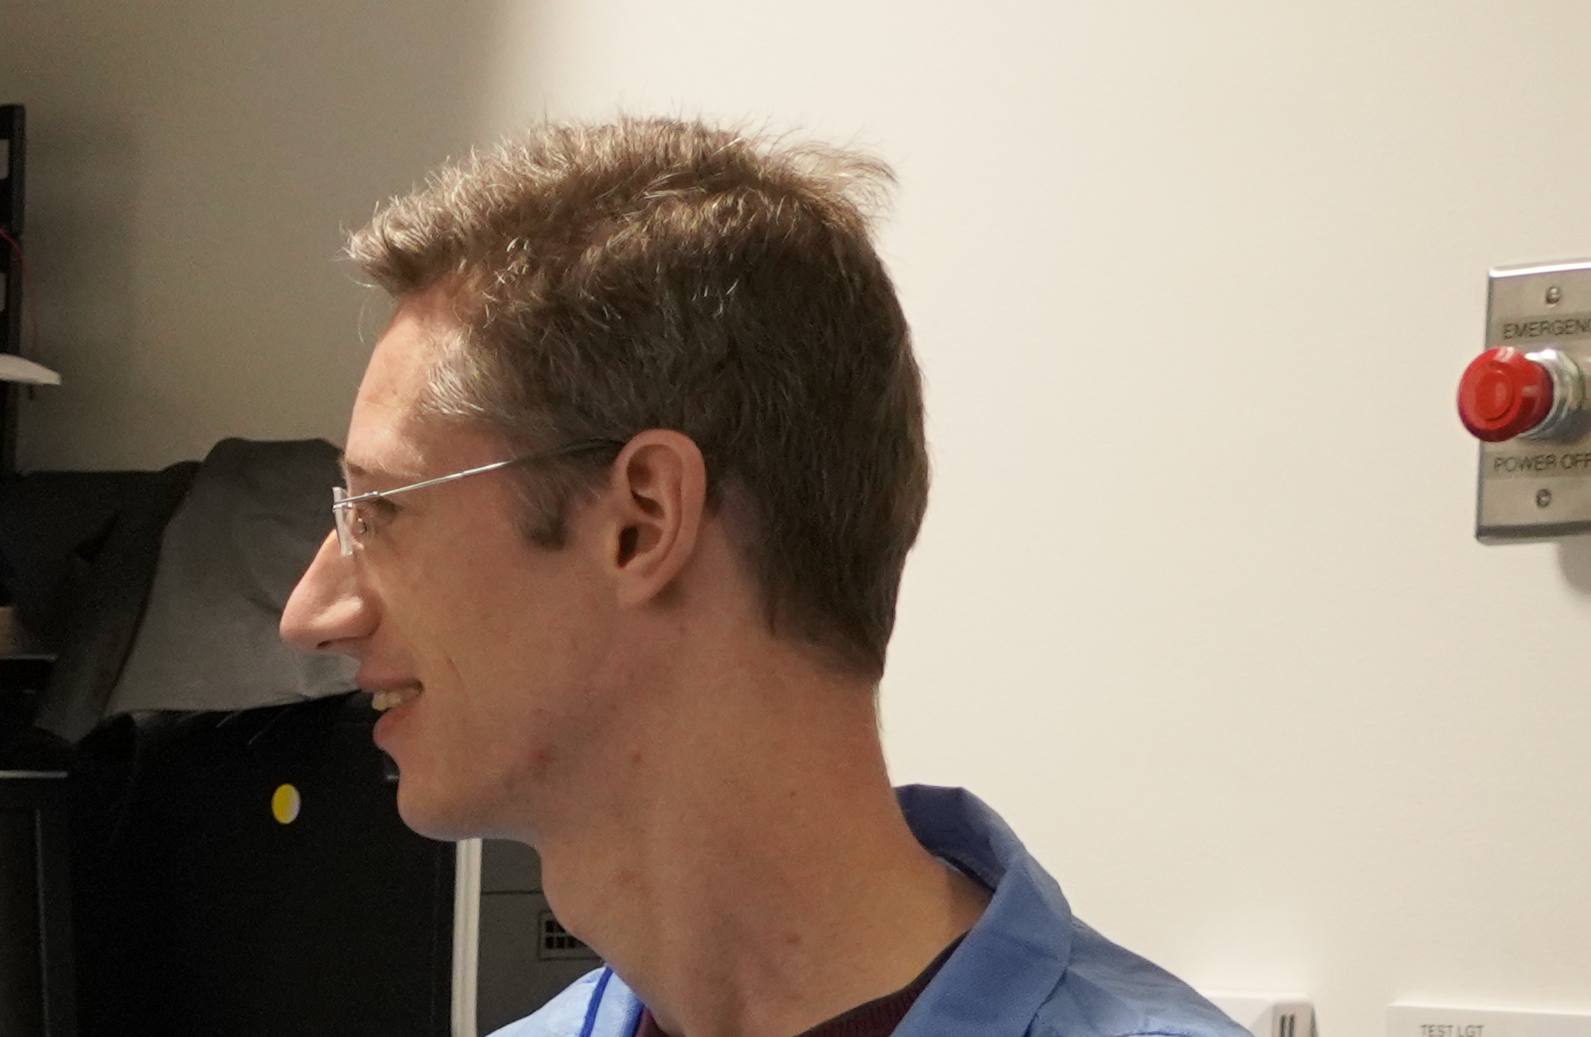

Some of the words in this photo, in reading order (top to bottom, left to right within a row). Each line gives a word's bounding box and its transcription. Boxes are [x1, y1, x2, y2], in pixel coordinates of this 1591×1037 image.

[1493, 453, 1557, 472] POWER
[1420, 1024, 1453, 1037] TEST
[1456, 1024, 1485, 1037] LGT
